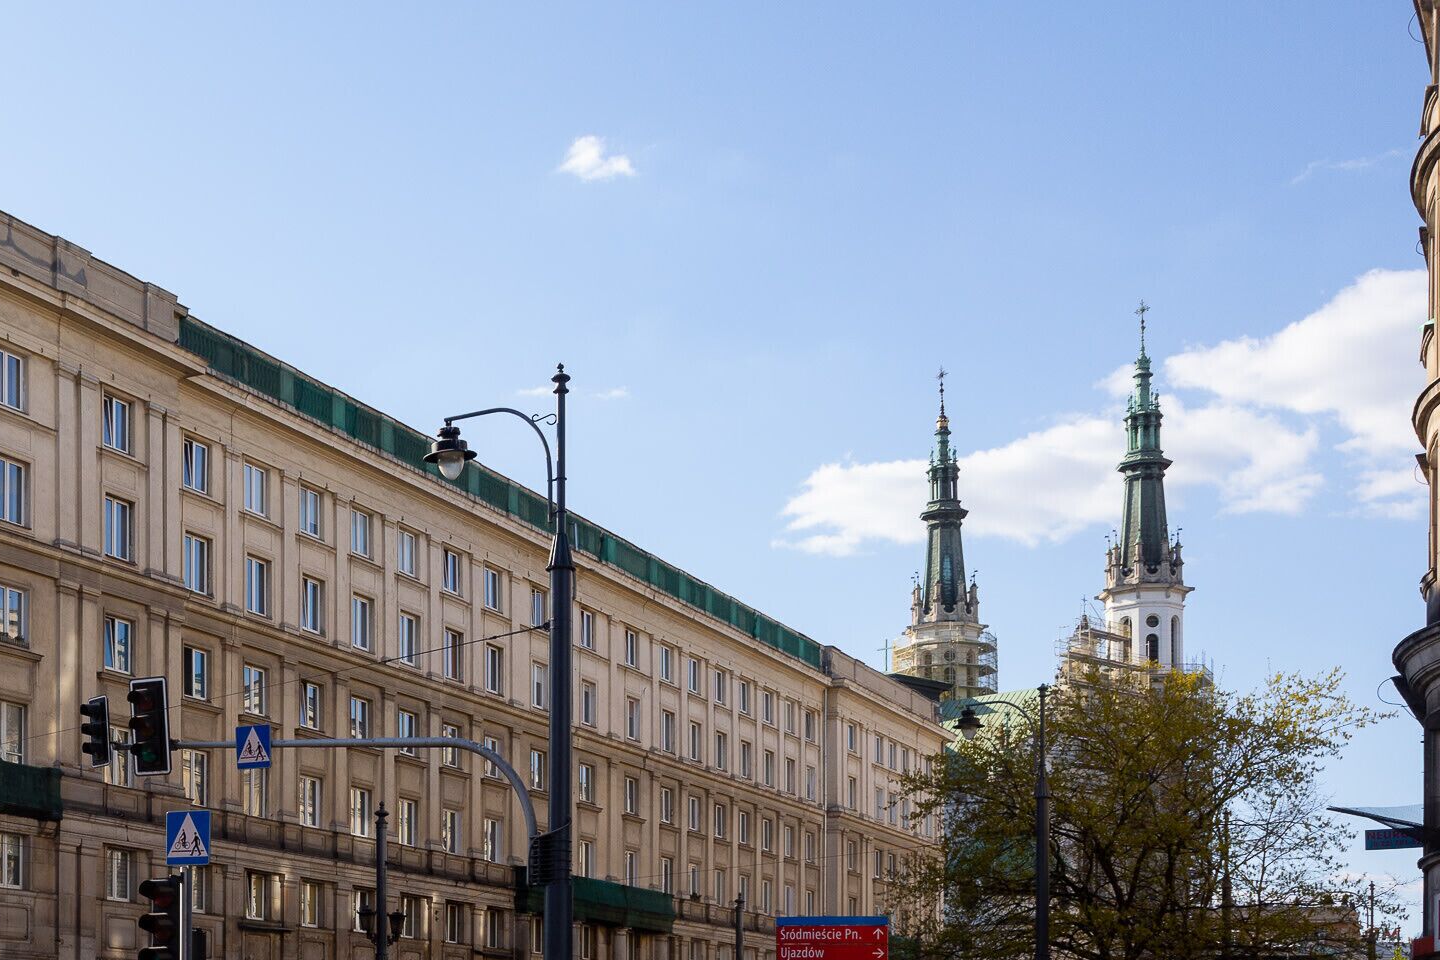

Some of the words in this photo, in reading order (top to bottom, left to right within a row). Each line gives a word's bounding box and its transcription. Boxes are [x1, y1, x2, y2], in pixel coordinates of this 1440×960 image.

[780, 927, 841, 941] Śródmieście
[844, 929, 862, 940] Pn.
[780, 947, 824, 960] Ujazdów
